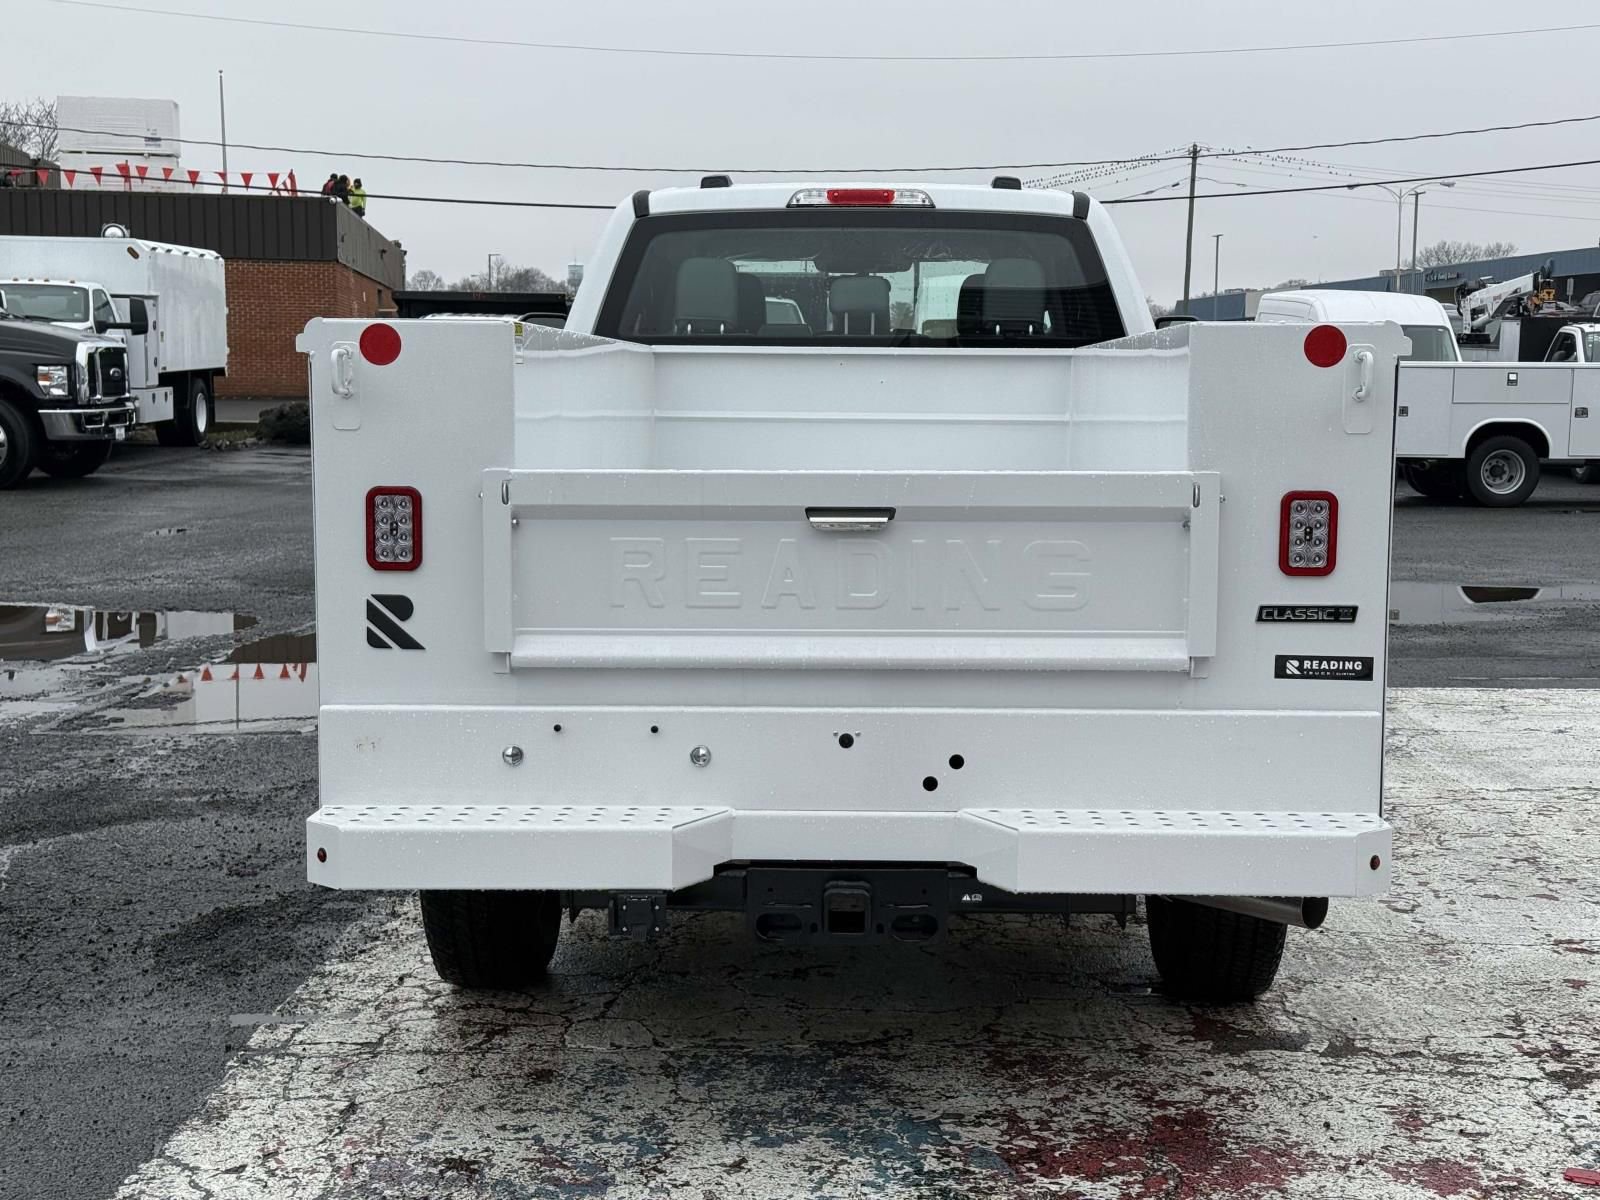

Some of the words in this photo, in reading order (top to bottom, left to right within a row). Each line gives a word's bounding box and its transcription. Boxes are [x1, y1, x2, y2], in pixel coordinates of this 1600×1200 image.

[608, 536, 1094, 612] READING
[1262, 607, 1335, 620] CLASSIC
[1303, 660, 1363, 671] READING
